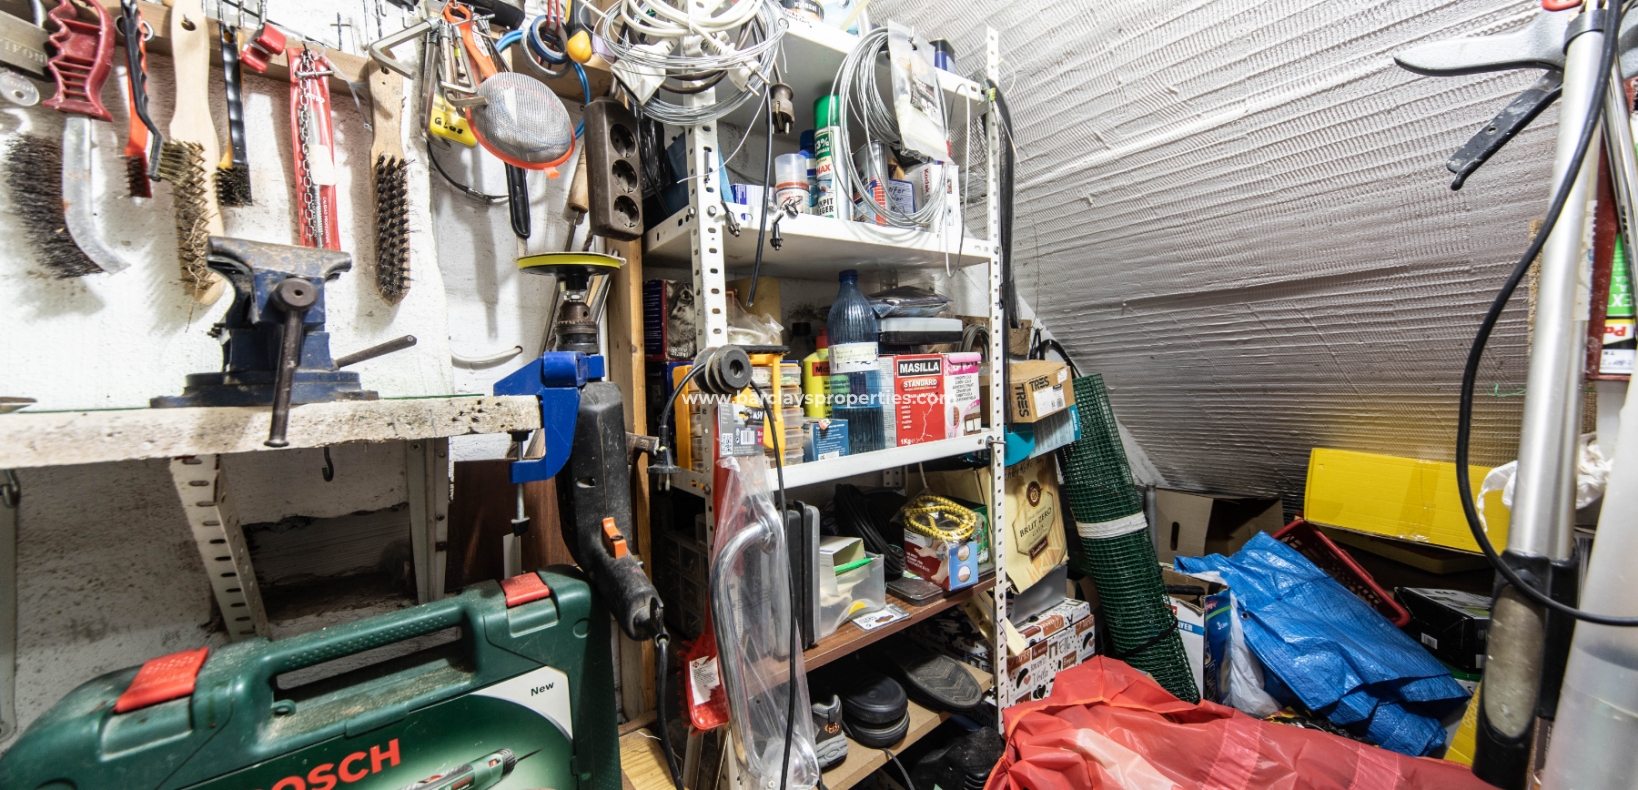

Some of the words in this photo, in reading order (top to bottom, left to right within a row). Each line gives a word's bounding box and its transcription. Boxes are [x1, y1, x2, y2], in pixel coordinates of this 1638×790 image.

[923, 168, 931, 193] Kodak
[899, 361, 940, 374] MASILLA
[903, 378, 938, 388] STANDARD
[1029, 376, 1050, 392] TRES
[1014, 383, 1030, 418] TRES
[1019, 519, 1038, 538] BRUT
[1038, 507, 1052, 524] ZERO
[530, 681, 555, 697] New
[253, 738, 401, 790] OSCH
